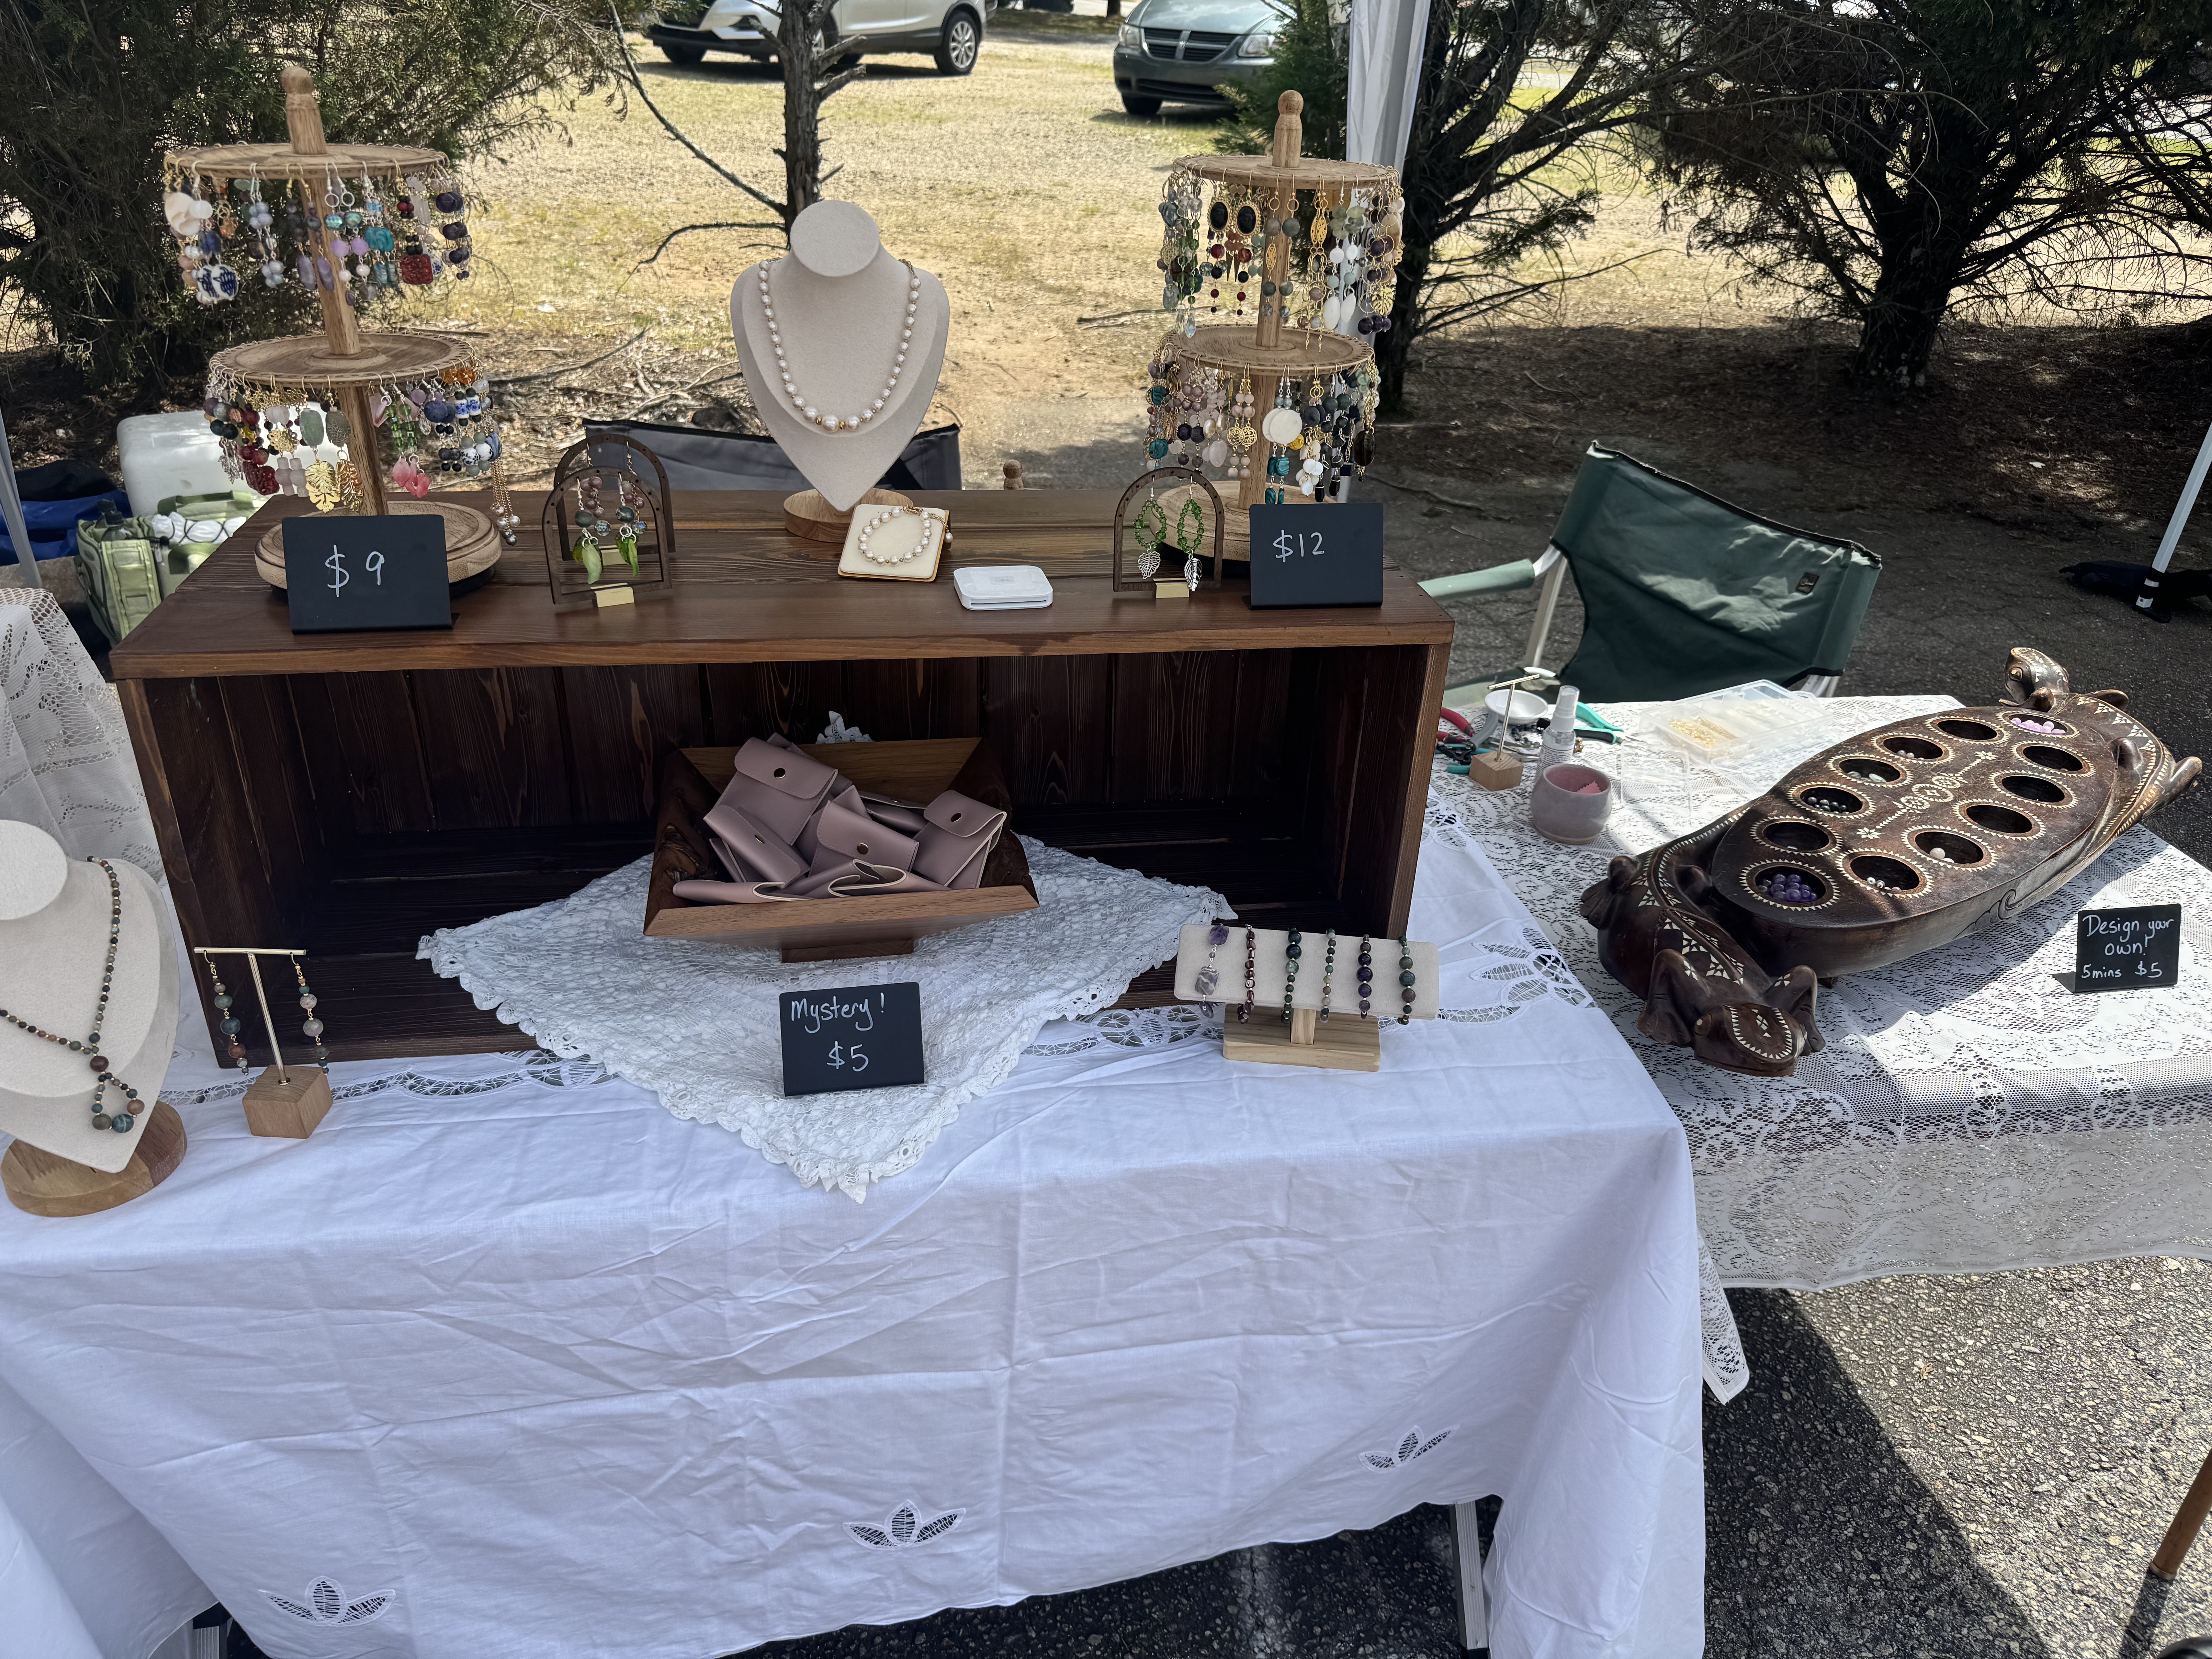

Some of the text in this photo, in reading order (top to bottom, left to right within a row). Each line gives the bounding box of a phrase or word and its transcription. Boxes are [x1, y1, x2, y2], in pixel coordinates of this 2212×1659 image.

[1273, 529, 1325, 563] $12
[2082, 914, 2174, 943] Design your
[2104, 934, 2148, 956] own!
[2081, 960, 2162, 979] 5mins $5
[826, 1041, 869, 1072] $5
